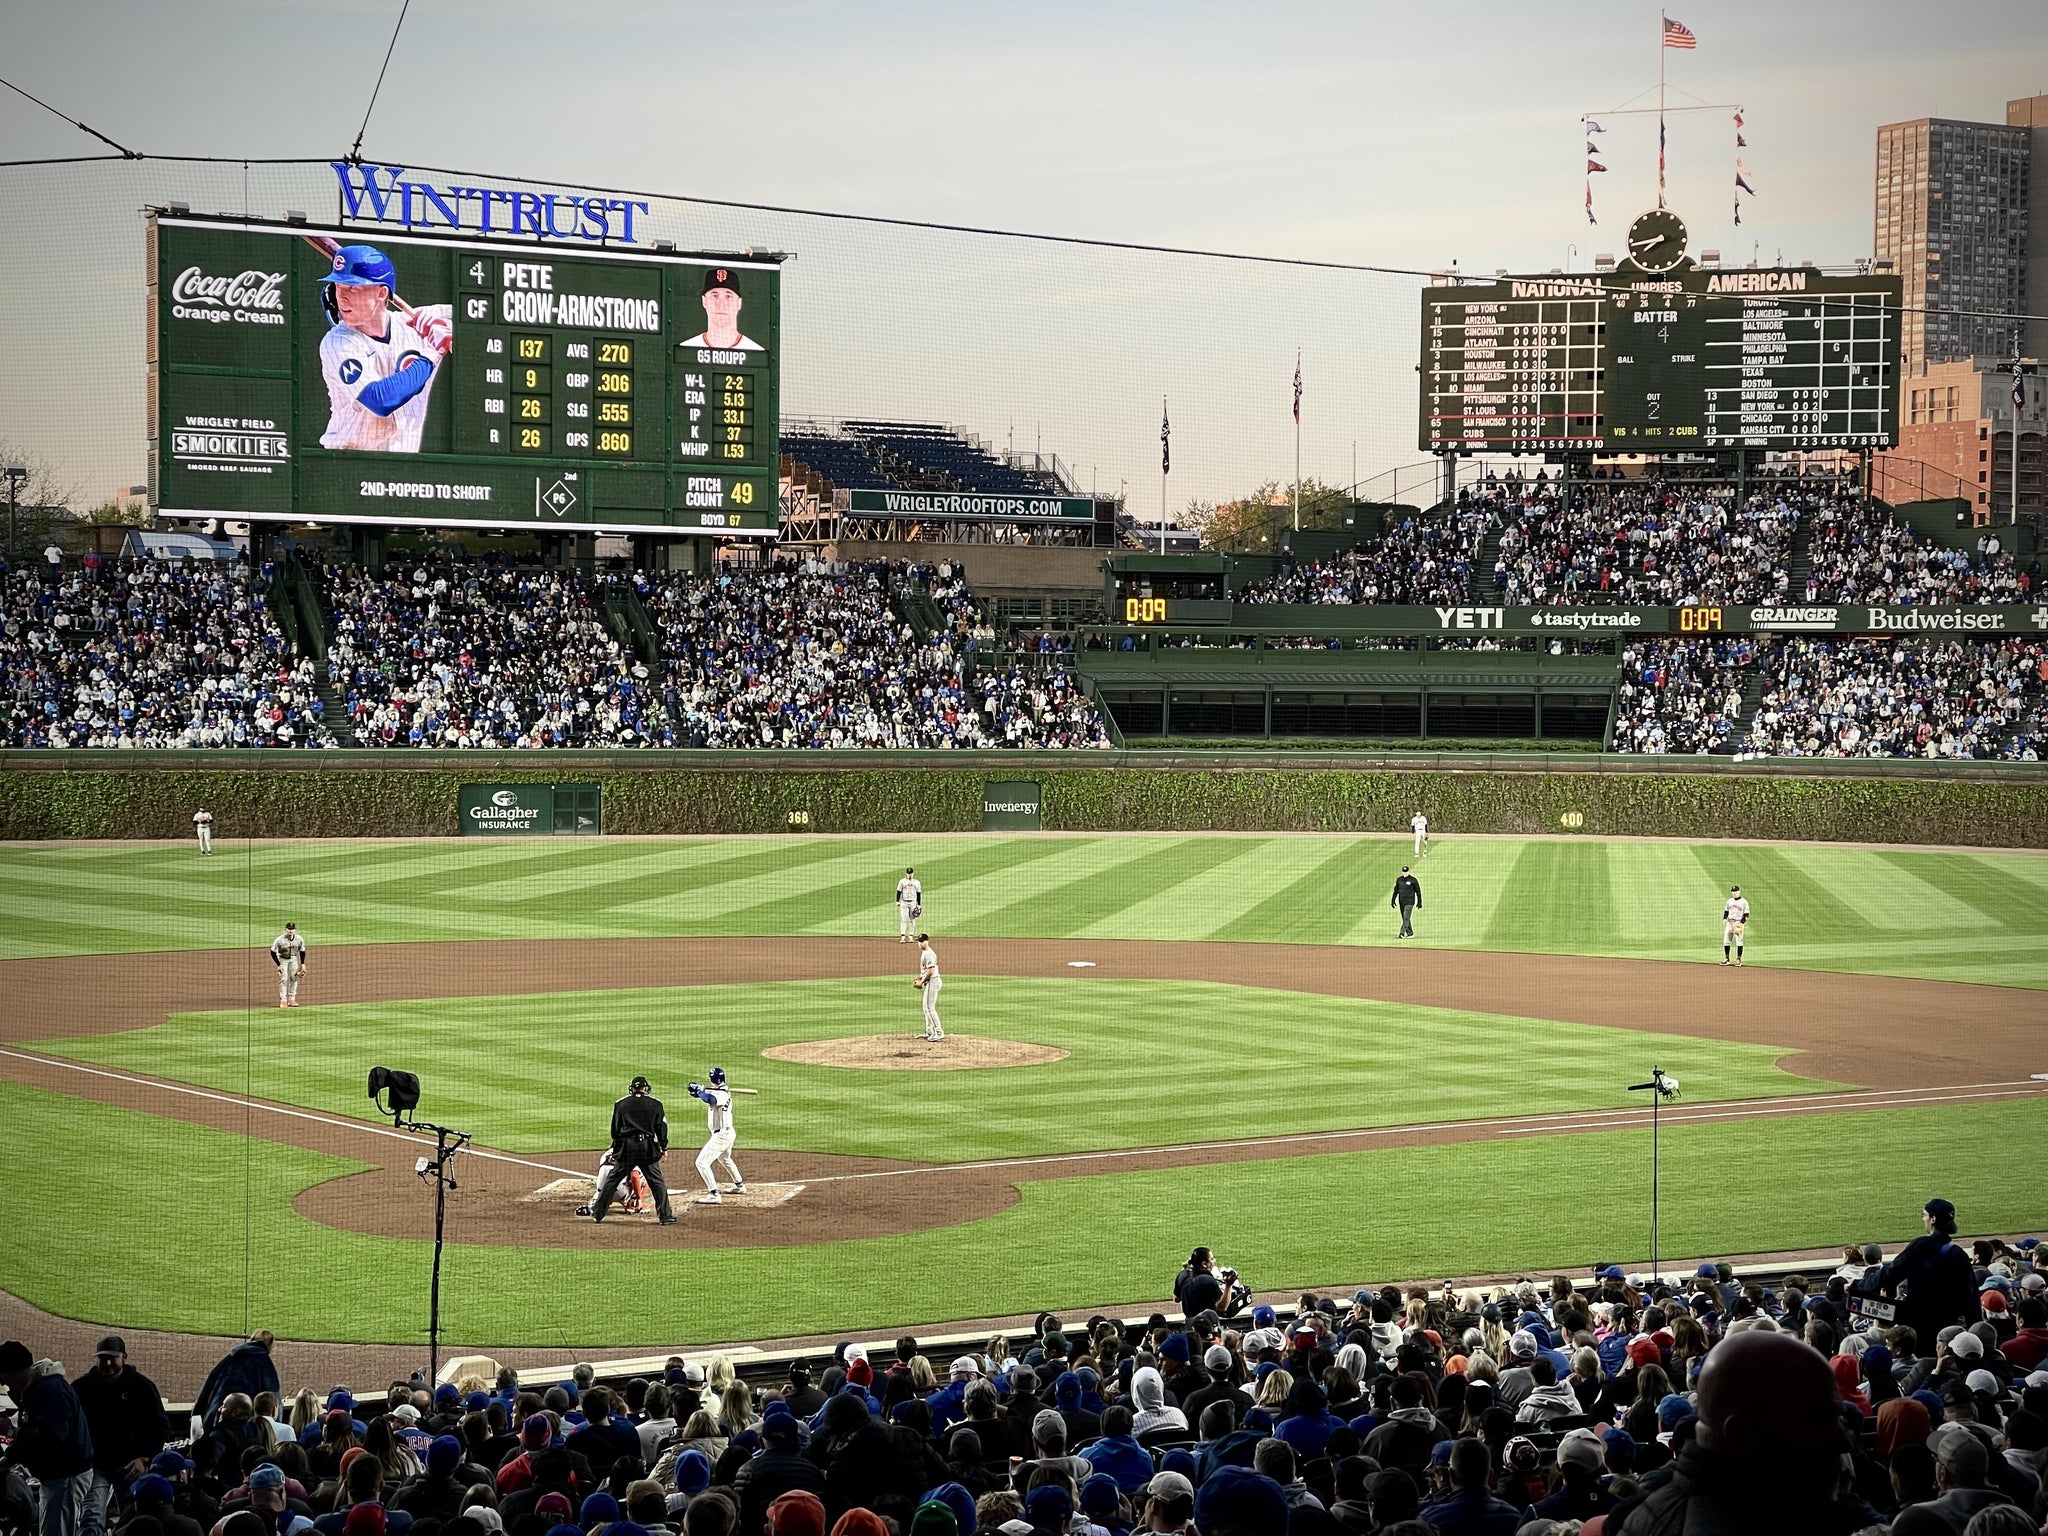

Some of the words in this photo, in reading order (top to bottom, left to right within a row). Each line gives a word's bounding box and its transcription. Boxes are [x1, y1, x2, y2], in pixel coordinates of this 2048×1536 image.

[330, 162, 648, 243] WINTRUST
[469, 260, 485, 285] 4
[503, 262, 552, 290] PETE
[172, 266, 287, 307] Coca-Cola
[1512, 278, 1606, 298] NATIONAL
[1631, 281, 1682, 292] UMPIRES
[1706, 273, 1806, 293] AMERICAN
[467, 299, 488, 319] CF
[1435, 306, 1441, 314] 4
[1465, 305, 1479, 313] NEW
[1480, 304, 1498, 313] YORK
[1664, 299, 1670, 308] 4
[172, 305, 231, 323] Orange
[233, 309, 284, 325] Cream
[503, 290, 659, 331] CROW-ARMSTRONG
[1634, 311, 1678, 323] BATTER
[1743, 310, 1755, 319] LOS
[1756, 309, 1782, 318] ANGELES
[1804, 309, 1810, 317] N
[1465, 315, 1496, 325] ARIZONA
[1742, 321, 1784, 330] BALTIMORE
[1433, 328, 1442, 336] 15
[1465, 327, 1504, 336] CINCINNATI
[1658, 326, 1670, 343] 4
[1742, 332, 1786, 342] MINNESOTA
[486, 338, 502, 353] AB
[519, 339, 543, 358] 137
[1432, 339, 1442, 348] 13
[1464, 338, 1498, 347] ATLANTA
[1742, 344, 1787, 353] PHILADELPHIA
[1834, 342, 1840, 351] G
[566, 343, 588, 358] AVG
[598, 344, 629, 363] .270
[1434, 351, 1441, 360] 3
[1464, 350, 1495, 359] HOUSTON
[697, 350, 710, 363] 65
[712, 351, 746, 365] ROUPP
[1742, 356, 1768, 365] TAMPA
[1769, 355, 1785, 365] BAY
[1843, 354, 1849, 363] A
[1434, 362, 1440, 370] 8
[1464, 361, 1506, 370] MILWAUKEE
[1742, 367, 1764, 377] TEXAS
[1852, 366, 1860, 374] M
[486, 369, 502, 383] HR
[526, 370, 536, 388] 9
[566, 373, 589, 387] OBP
[685, 374, 706, 388] W-L
[725, 375, 743, 390] 2-2
[1434, 374, 1440, 382] 4
[1464, 372, 1475, 381] LOS
[1476, 372, 1500, 381] ANGELES
[1863, 377, 1868, 386] E
[597, 374, 629, 392] .306
[1435, 385, 1440, 393] 1
[1450, 384, 1458, 393] 10
[1464, 384, 1485, 393] MIAMI
[1742, 379, 1772, 388] BOSTON
[685, 390, 705, 404] ERA
[724, 392, 744, 407] 5.13
[1434, 396, 1439, 404] 9
[1464, 395, 1507, 404] PITTSBURGH
[1647, 393, 1661, 401] OUT
[1707, 392, 1718, 400] 13
[1741, 391, 1756, 400] SAN
[1756, 390, 1778, 400] DIEGO
[485, 399, 504, 413] RBI
[521, 399, 540, 417] 26
[567, 403, 588, 417] SLG
[598, 403, 629, 422] .555
[1434, 407, 1439, 416] 9
[1463, 407, 1475, 415] ST.
[1476, 407, 1496, 415] LOUIS
[1648, 402, 1659, 420] 2
[1741, 402, 1756, 412] NEW
[1757, 402, 1776, 411] YORK
[690, 408, 700, 421] IP
[724, 409, 744, 424] 33.1
[1741, 414, 1773, 423] CHICAGO
[185, 416, 239, 428] WRIGLEY
[241, 419, 275, 430] FIELD
[1431, 418, 1441, 427] 65
[1463, 418, 1475, 426] SAN
[1476, 418, 1507, 426] FRANCISCO
[490, 429, 499, 443] R
[691, 425, 699, 439] K
[727, 427, 741, 441] 37
[1432, 430, 1440, 438] 16
[1463, 429, 1484, 438] CUBS
[1614, 428, 1626, 436] VIS
[1632, 427, 1638, 436] 4
[1645, 428, 1662, 436] HITS
[1669, 427, 1674, 436] 2
[1676, 427, 1698, 435] CUBS
[1707, 426, 1717, 435] 13
[1741, 426, 1769, 434] KANSAS
[1770, 425, 1786, 434] CITY
[521, 429, 540, 447] 26
[566, 432, 588, 447] OPS
[597, 433, 629, 451] .860
[1707, 438, 1716, 446] SP
[1725, 438, 1734, 446] RP
[1744, 438, 1768, 446] INNING
[681, 442, 708, 456] WHIP
[724, 444, 744, 458] 1.53
[1431, 441, 1440, 449] SP
[1448, 441, 1457, 449] RP
[1466, 441, 1488, 449] INNING
[564, 472, 577, 481] 2nd
[360, 481, 433, 498] 2ND-POPPED
[435, 484, 450, 499] TO
[452, 485, 491, 500] SHORT
[688, 477, 721, 492] PITCH
[553, 492, 565, 504] P6
[686, 492, 724, 507] COUNT
[730, 482, 752, 504] 49
[700, 513, 725, 526] BOYD
[729, 515, 741, 526] 67
[1126, 598, 1166, 621] 0:09
[1750, 608, 1838, 622] GRAINGER
[1435, 607, 1504, 628] YETI
[1544, 612, 1641, 630] tastytrade
[1680, 608, 1722, 631] 0:09
[1867, 608, 2003, 630] Budweiser
[470, 806, 539, 821] Gallagher
[984, 801, 1038, 814] Invenergy
[788, 811, 809, 824] 368
[1560, 812, 1583, 826] 400
[478, 821, 530, 829] INSURANCE
